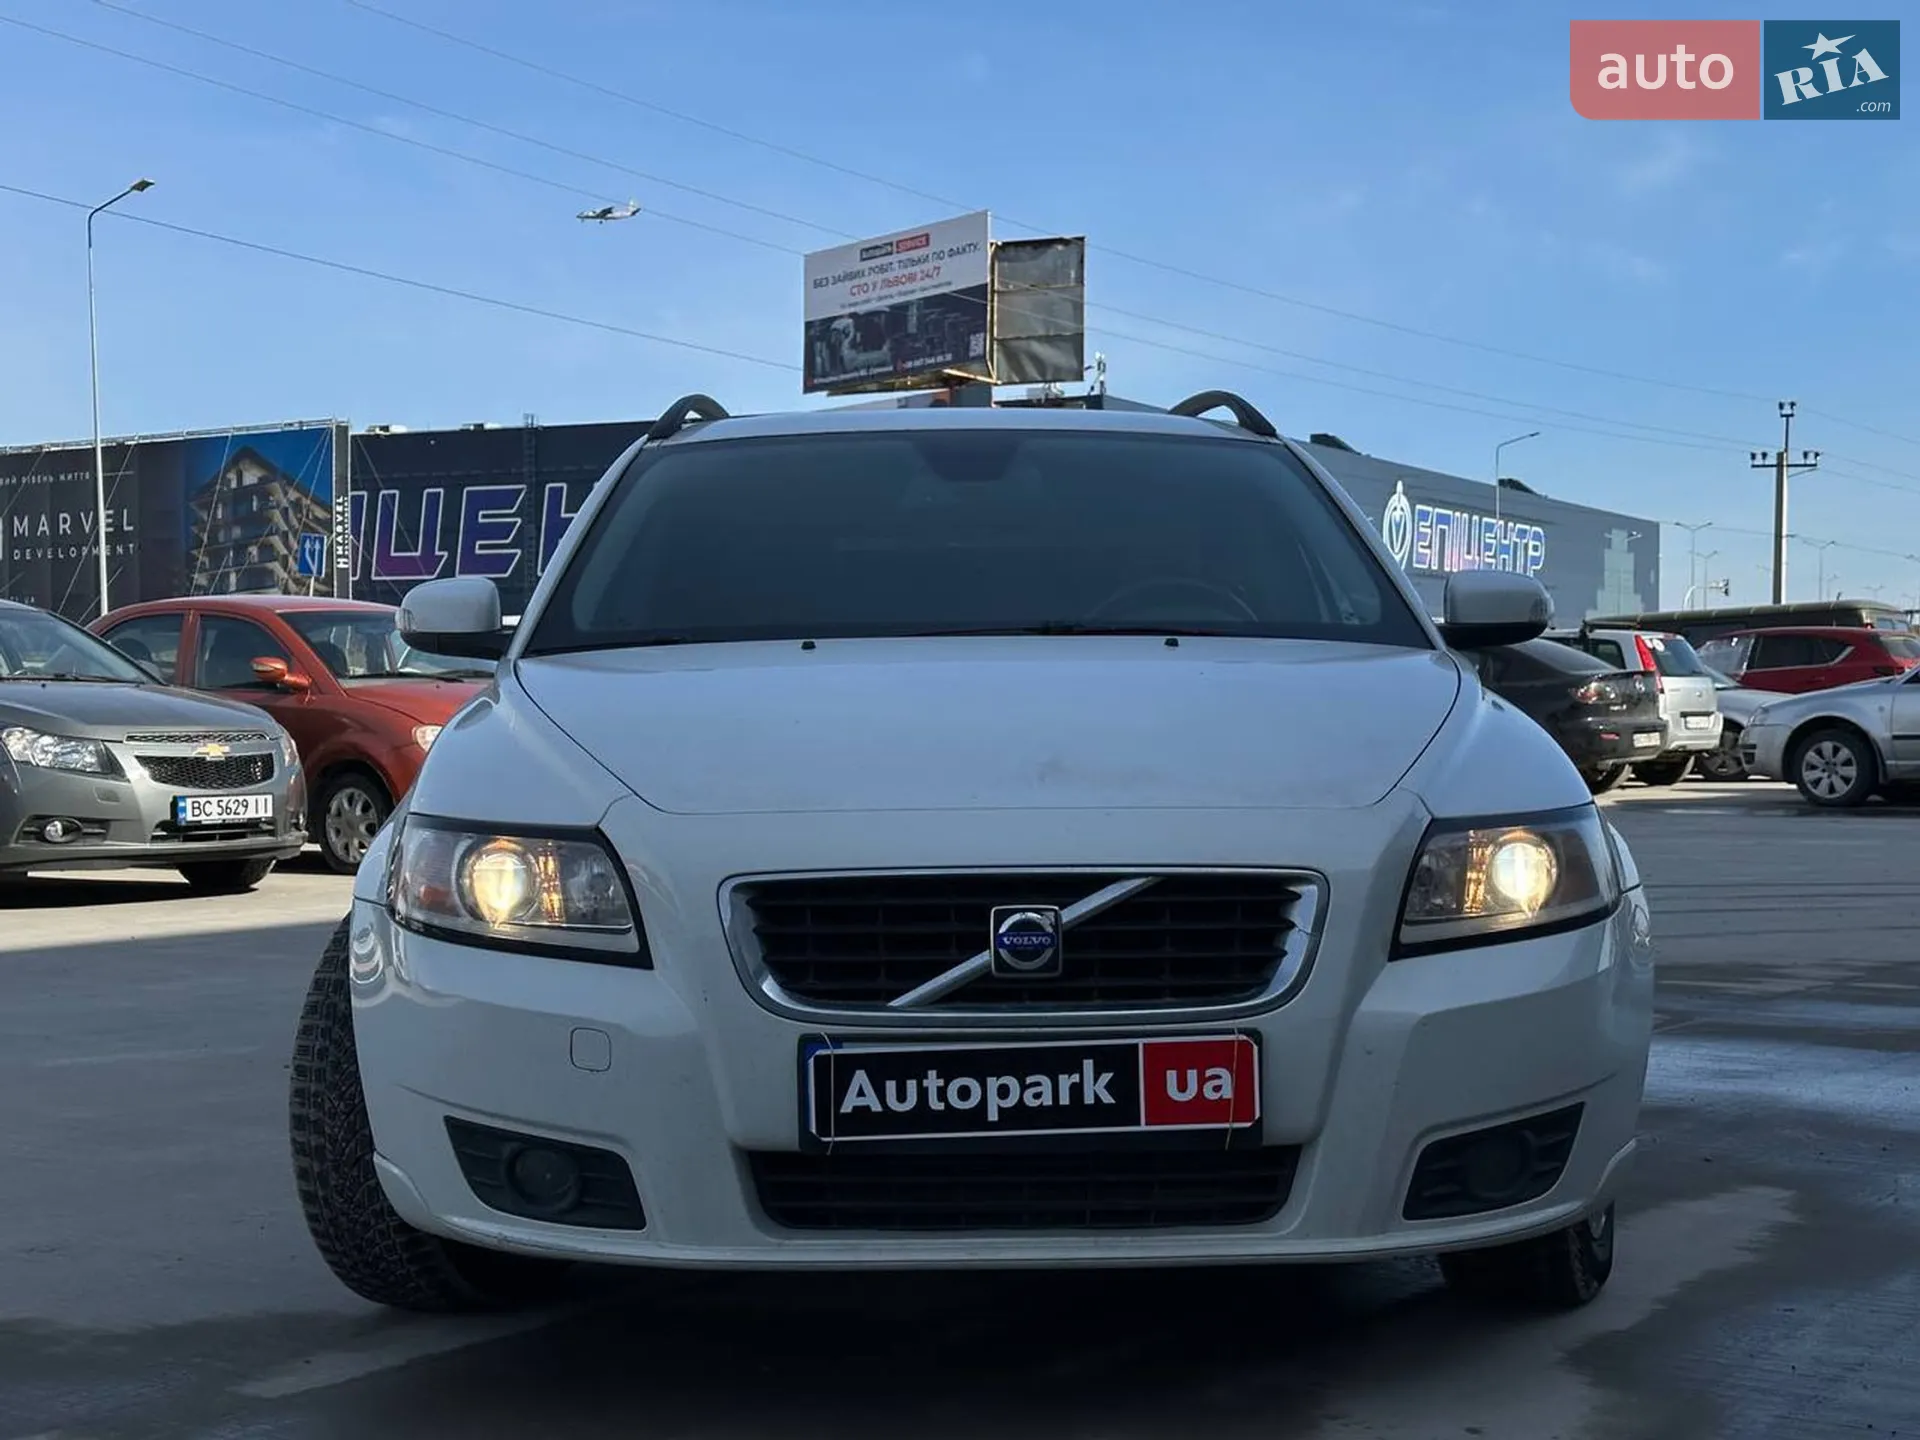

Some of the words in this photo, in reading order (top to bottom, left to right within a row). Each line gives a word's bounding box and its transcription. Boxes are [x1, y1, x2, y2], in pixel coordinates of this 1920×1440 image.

[932, 250, 946, 264] ПО
[850, 282, 870, 297] СТО
[919, 265, 941, 282] 24/7
[13, 508, 134, 538] MARVEL
[13, 543, 135, 561] DEVELOPMENT
[1412, 503, 1545, 577] ЕПІЦЕНТР
[191, 800, 213, 817] BC
[216, 797, 249, 816] 5629
[1003, 935, 1051, 946] VOLVO
[839, 1059, 1116, 1122] Autopark
[1165, 1067, 1234, 1102] ua
